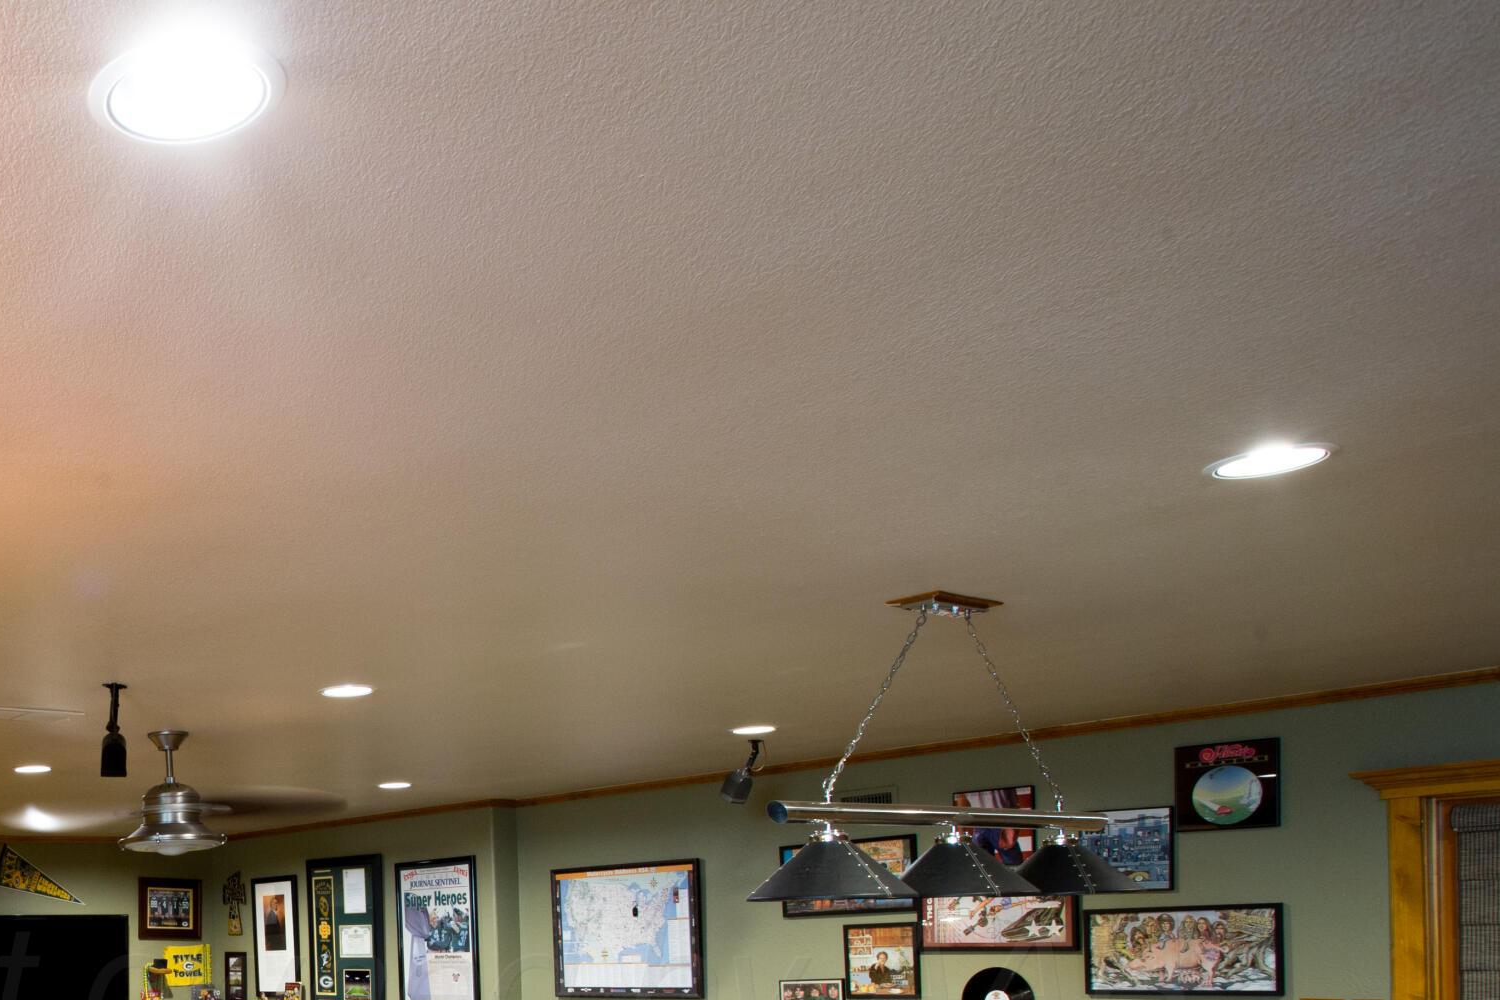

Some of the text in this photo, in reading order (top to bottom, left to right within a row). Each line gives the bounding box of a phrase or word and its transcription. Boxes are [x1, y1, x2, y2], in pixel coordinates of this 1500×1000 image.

[435, 878, 461, 887] SENTINEL
[405, 891, 468, 910] Super Heroes
[173, 953, 203, 964] TITLE
[173, 970, 203, 978] TOWEL
